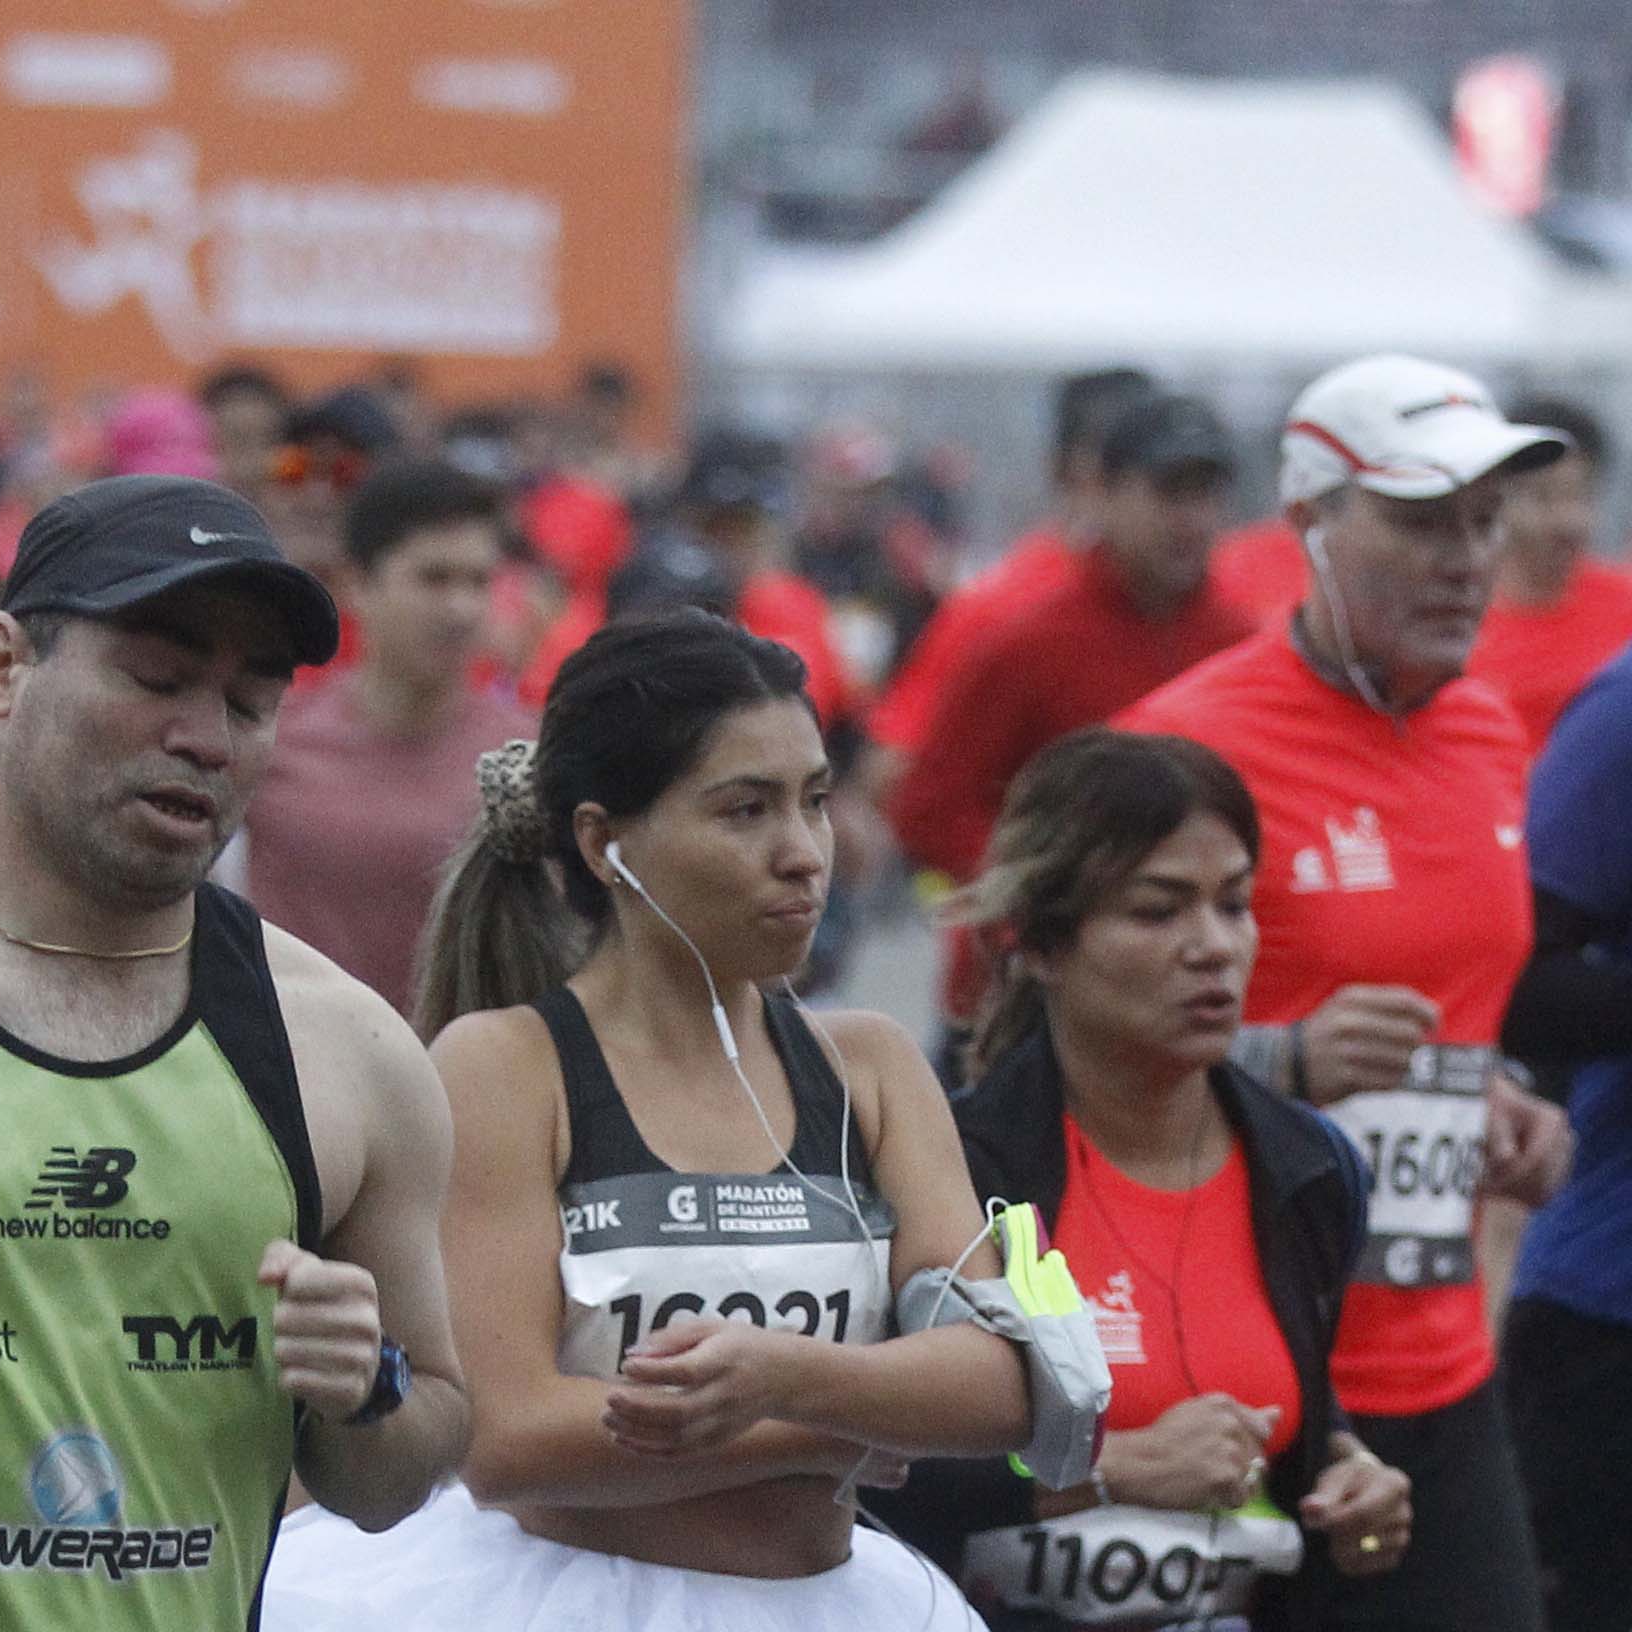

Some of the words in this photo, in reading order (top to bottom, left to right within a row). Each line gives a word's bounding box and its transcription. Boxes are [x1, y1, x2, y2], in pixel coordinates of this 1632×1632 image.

[717, 1182, 805, 1203] MARATÓN
[52, 1212, 171, 1240] balance
[567, 1200, 622, 1234] 21K
[122, 1315, 257, 1360] TYM
